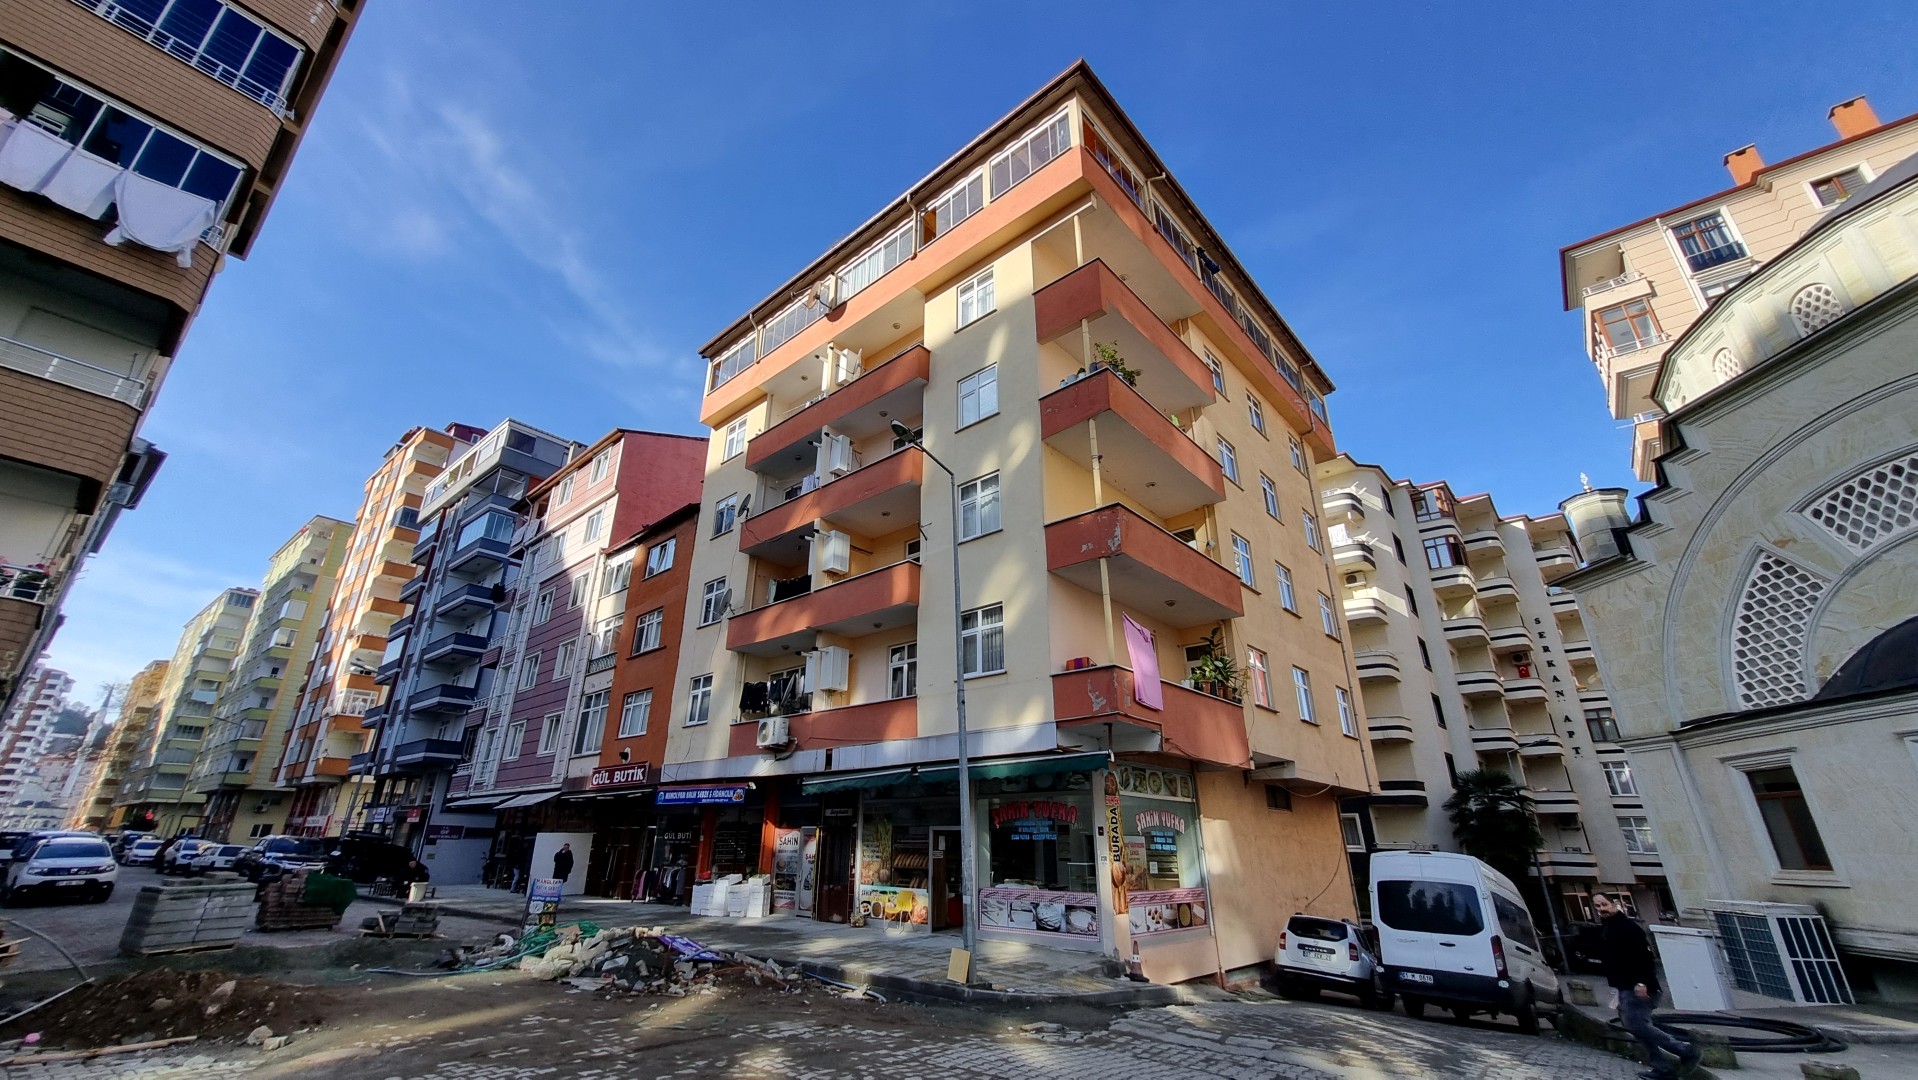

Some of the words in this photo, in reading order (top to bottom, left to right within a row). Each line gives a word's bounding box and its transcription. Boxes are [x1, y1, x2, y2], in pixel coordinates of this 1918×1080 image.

[1534, 617, 1565, 698] SERKAN
[592, 769, 611, 785] GÜL
[613, 766, 645, 783] BUTİK
[1033, 800, 1079, 826] YUFKA
[1135, 810, 1160, 836] ŞAHİN
[1160, 811, 1185, 835] YUFKA
[778, 836, 799, 849] ŞAHİN
[1110, 807, 1121, 862] BURADA
